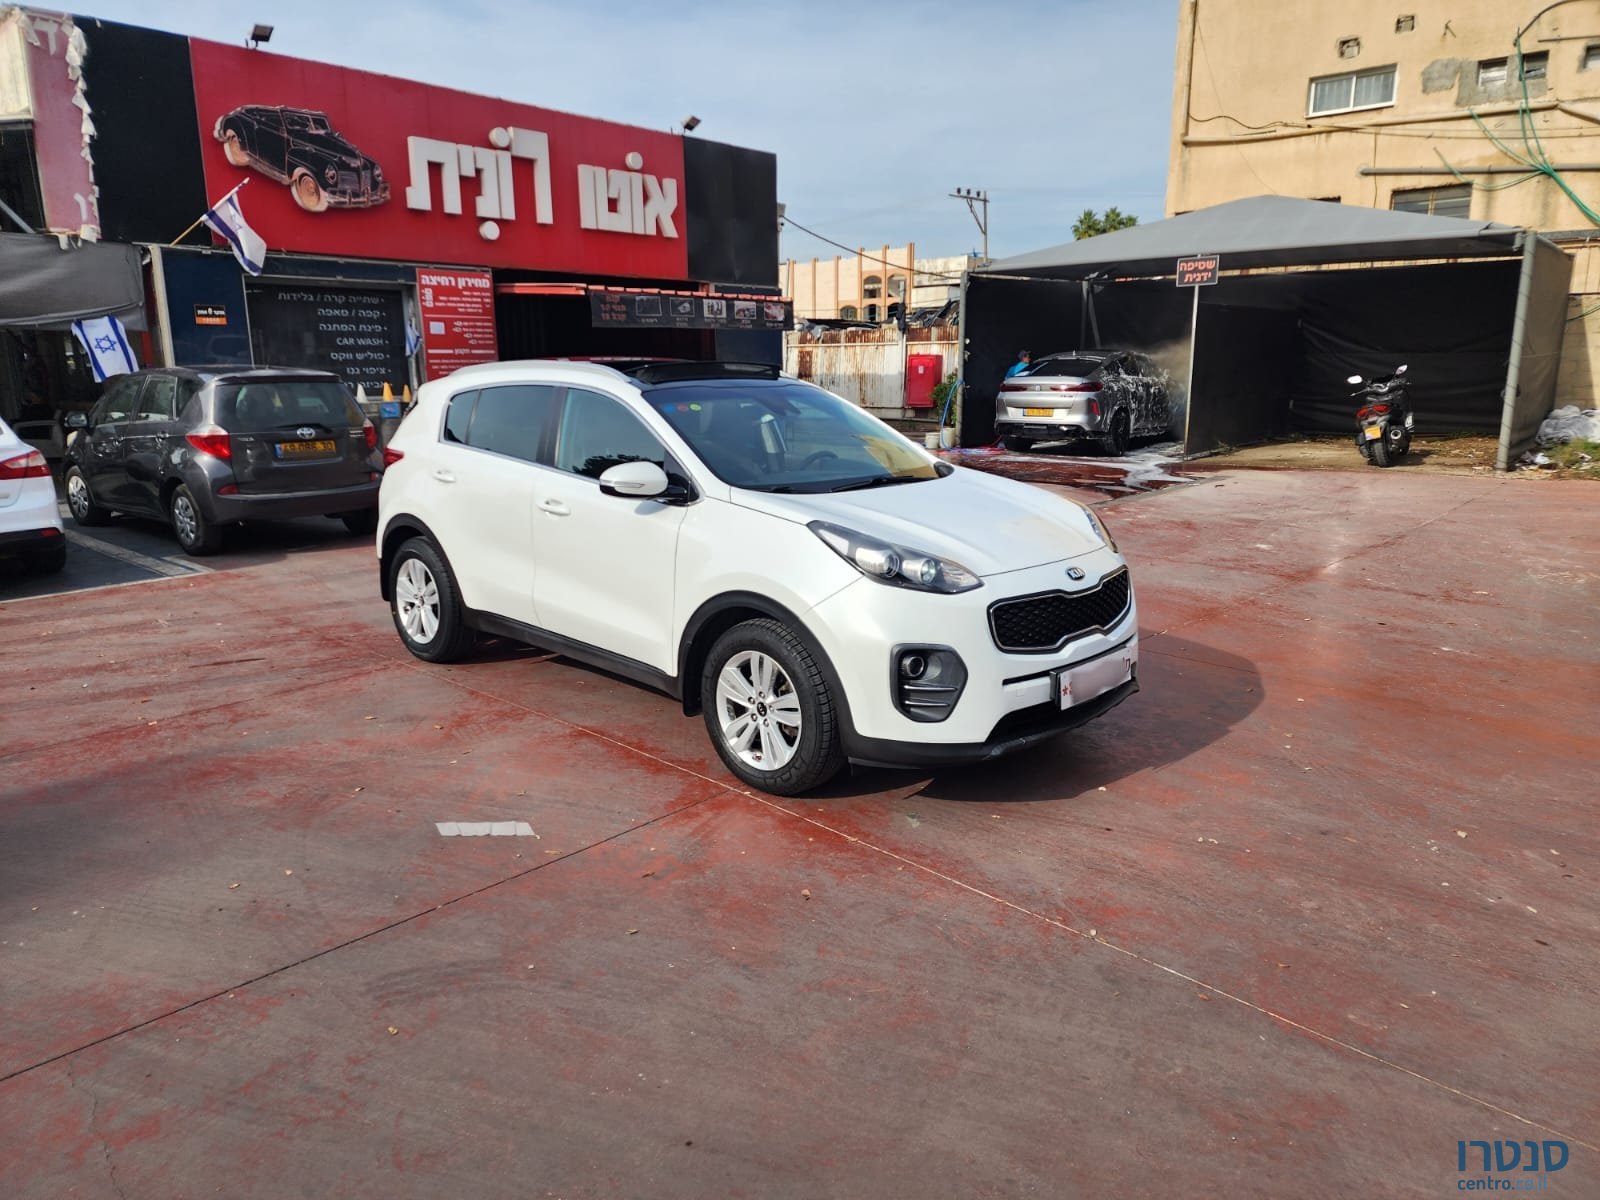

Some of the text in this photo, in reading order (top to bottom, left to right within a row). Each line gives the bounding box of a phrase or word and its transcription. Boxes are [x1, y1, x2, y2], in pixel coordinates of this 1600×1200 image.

[1180, 259, 1216, 271] שטיפה
[421, 275, 490, 289] מחירון רחיצה
[1184, 271, 1212, 283] ידנית
[278, 291, 314, 301] גלידות
[323, 294, 346, 305] קרה
[358, 310, 380, 320] קפה
[319, 323, 382, 333] פינת המתנה
[336, 337, 384, 346] CAR WASH
[355, 351, 385, 360] פוליש
[1067, 568, 1086, 579] KIA
